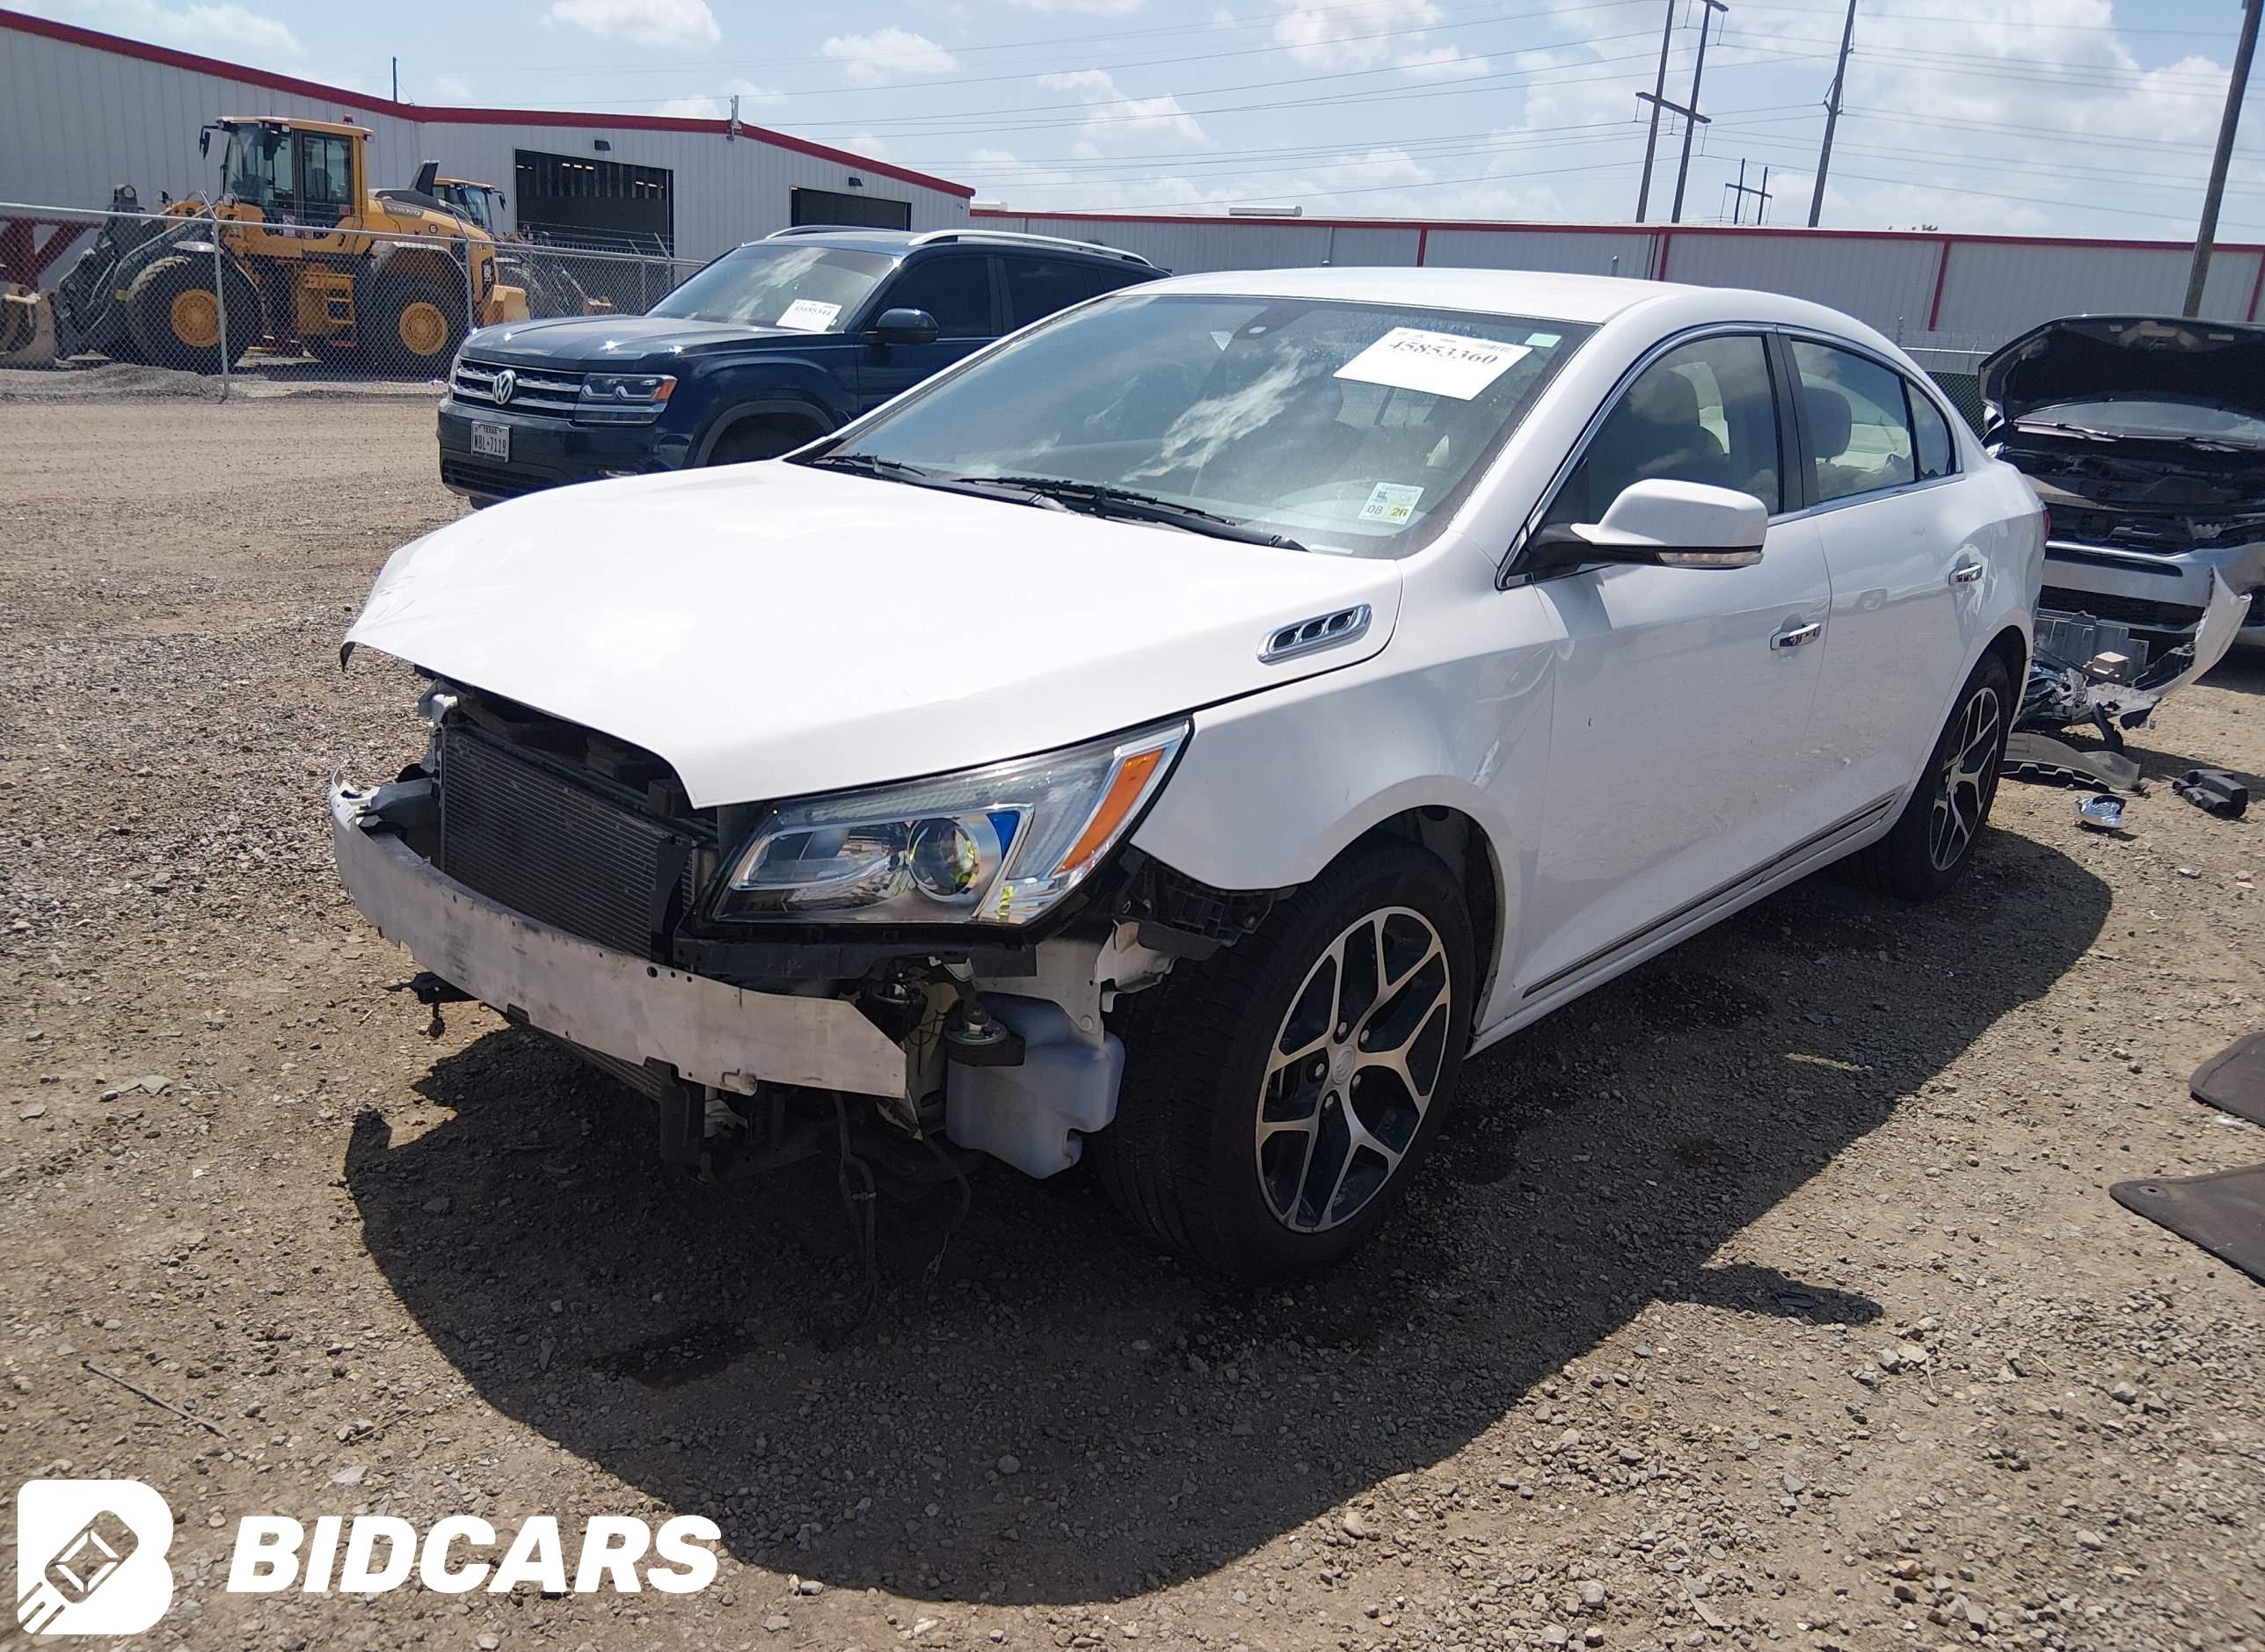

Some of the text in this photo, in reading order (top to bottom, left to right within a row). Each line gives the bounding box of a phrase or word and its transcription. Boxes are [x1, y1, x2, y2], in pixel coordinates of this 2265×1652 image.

[387, 205, 421, 216] VOLVO
[1389, 340, 1498, 364] 45853360
[484, 426, 498, 435] TEXAS
[1366, 505, 1384, 515] 08
[1391, 506, 1409, 517] 26
